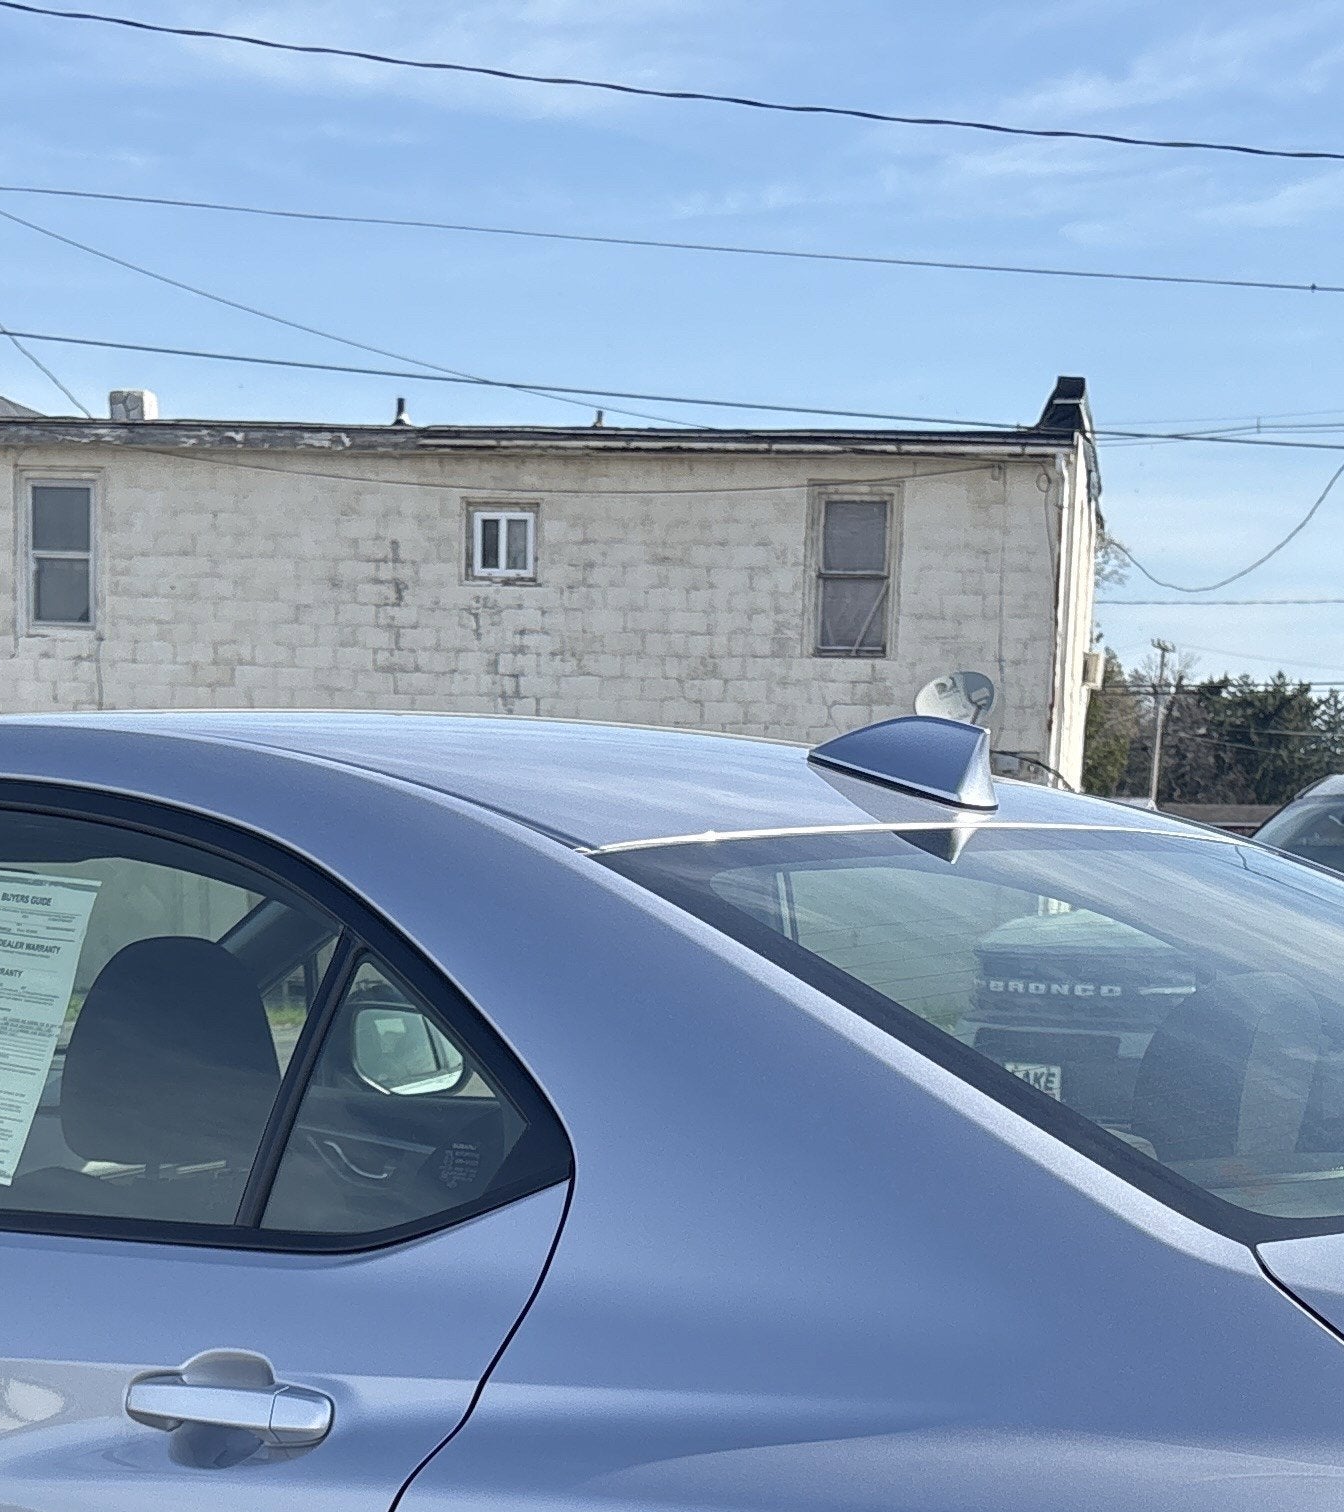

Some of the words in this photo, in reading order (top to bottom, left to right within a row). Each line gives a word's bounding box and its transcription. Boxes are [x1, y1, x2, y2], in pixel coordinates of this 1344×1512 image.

[1, 892, 30, 904] BUYERS
[30, 896, 52, 906] GUIDE
[25, 943, 61, 954] WARRANTY
[988, 979, 1123, 997] BRONCO
